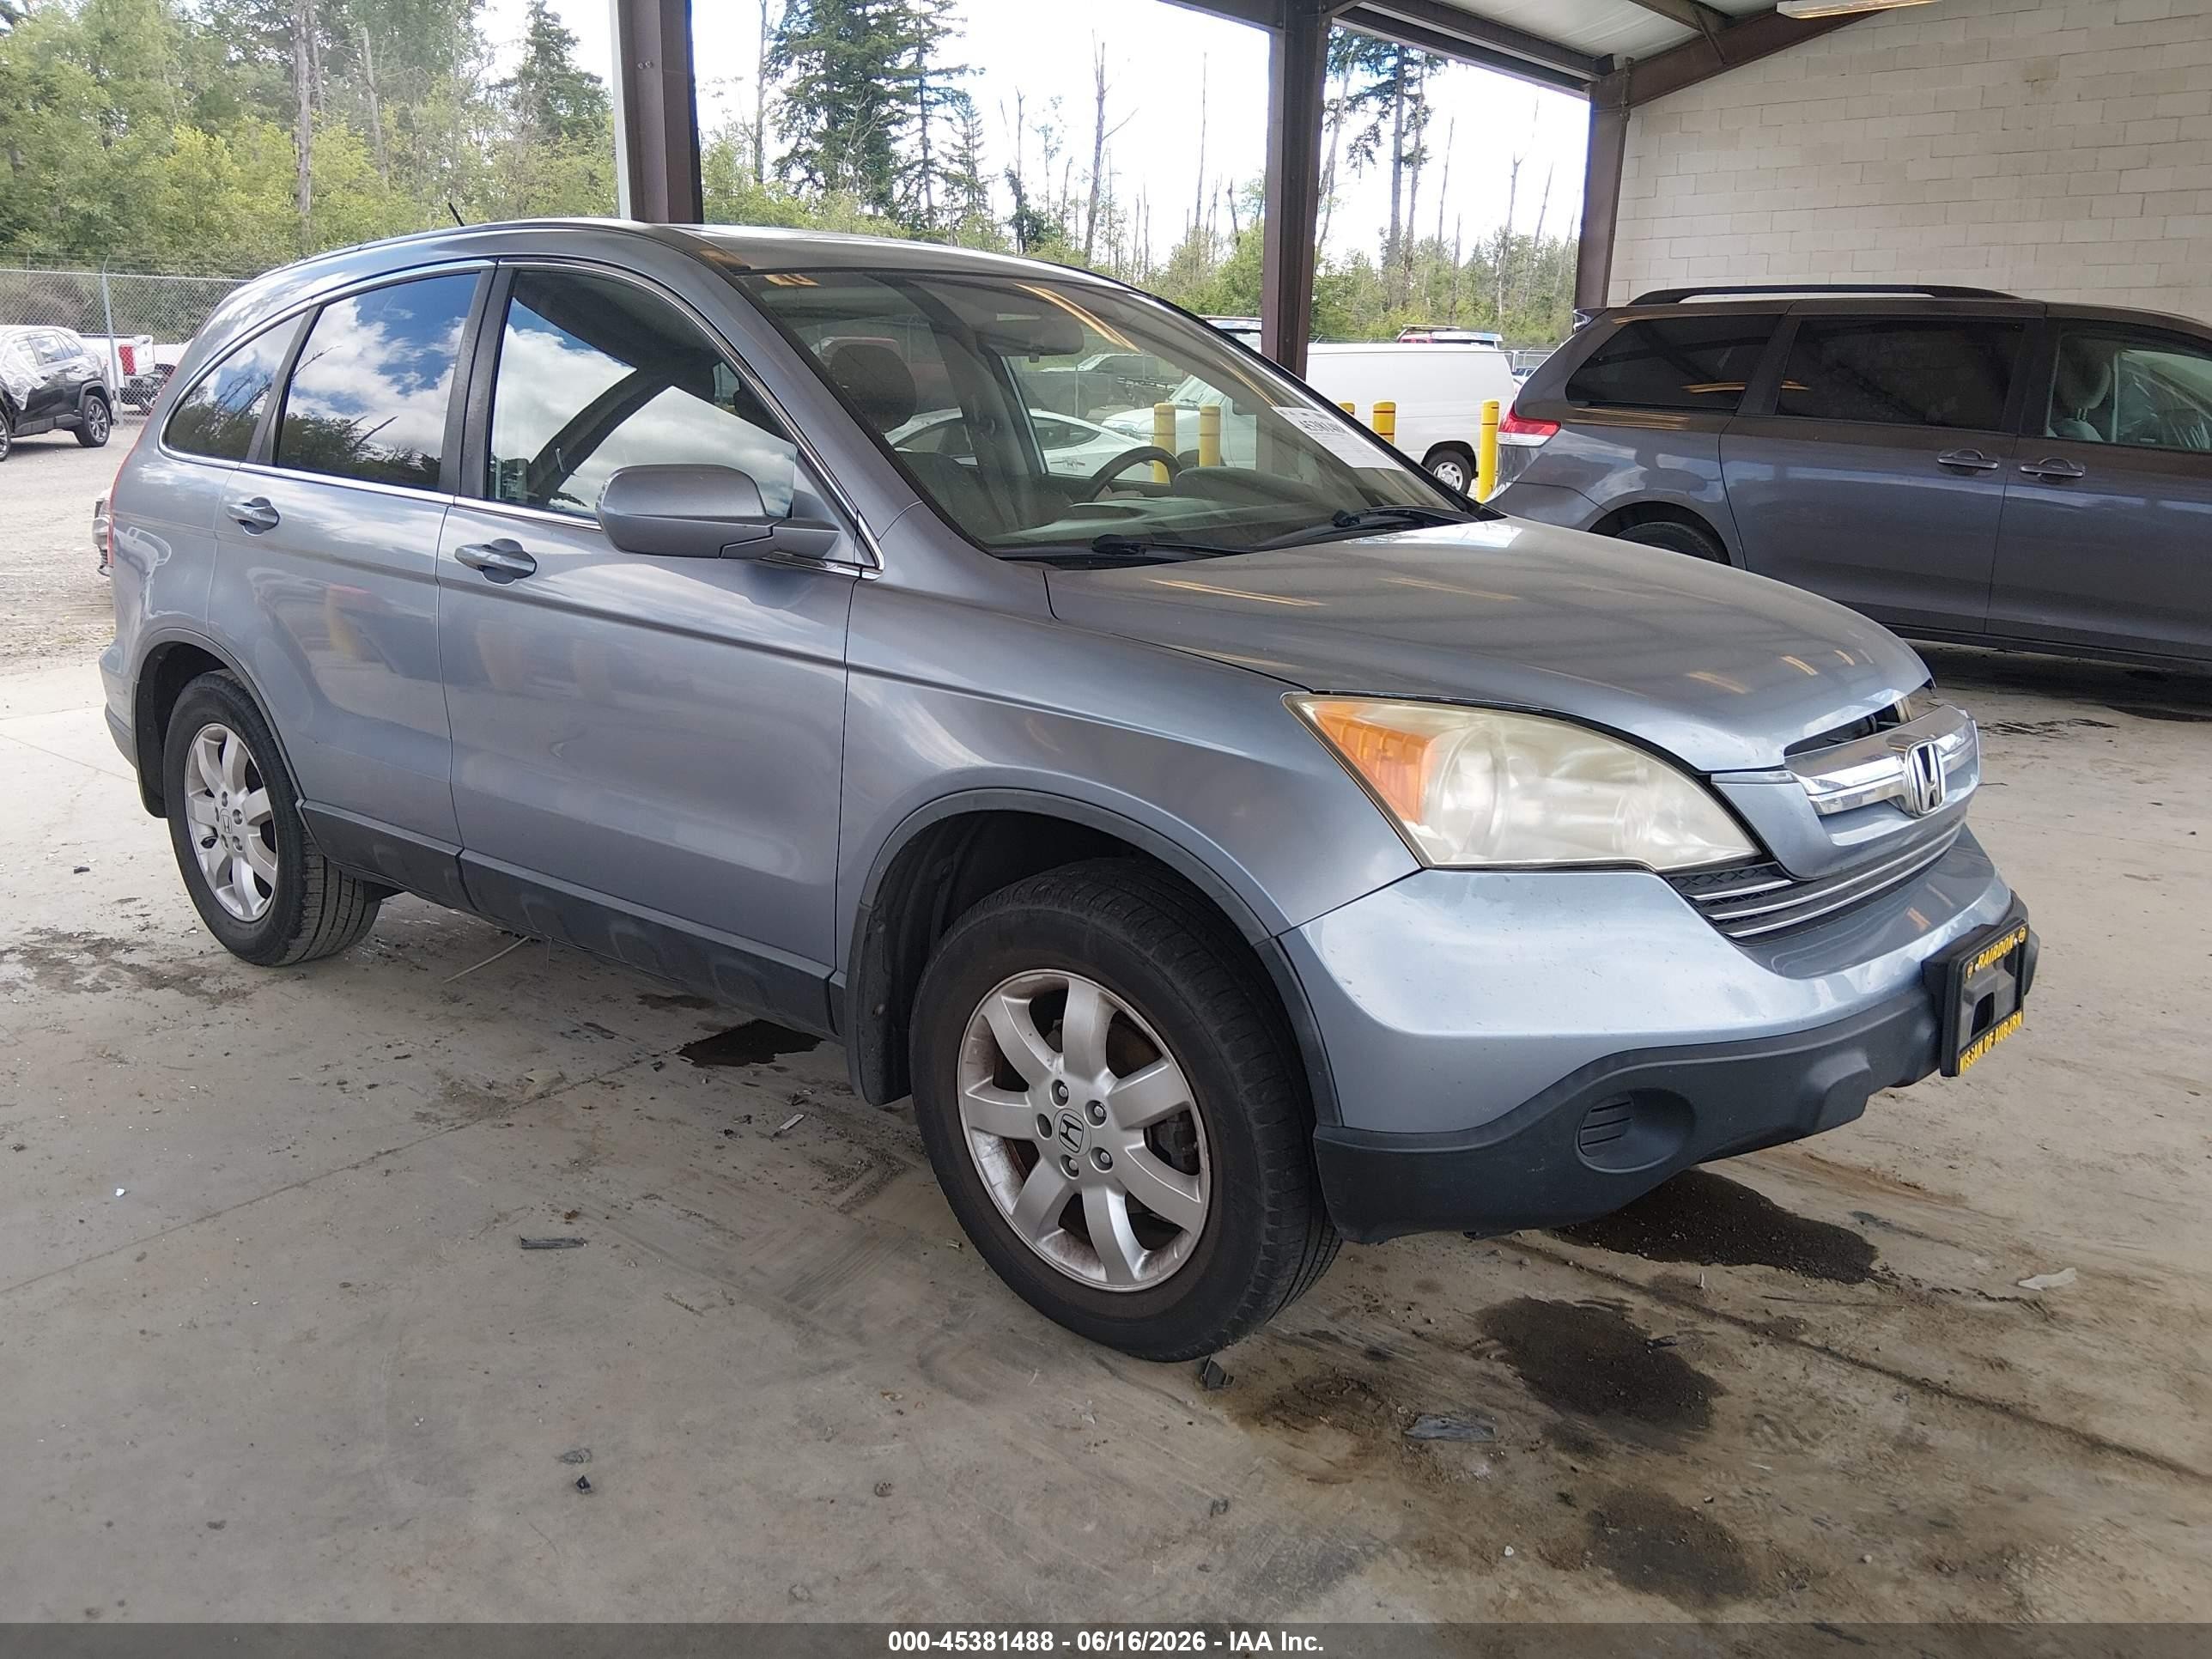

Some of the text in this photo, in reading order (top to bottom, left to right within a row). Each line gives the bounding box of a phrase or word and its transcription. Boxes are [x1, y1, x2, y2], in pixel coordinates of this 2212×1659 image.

[1978, 933, 2015, 969] RAIRDON
[1959, 1011, 2023, 1077] NISSAN OF AUBURN
